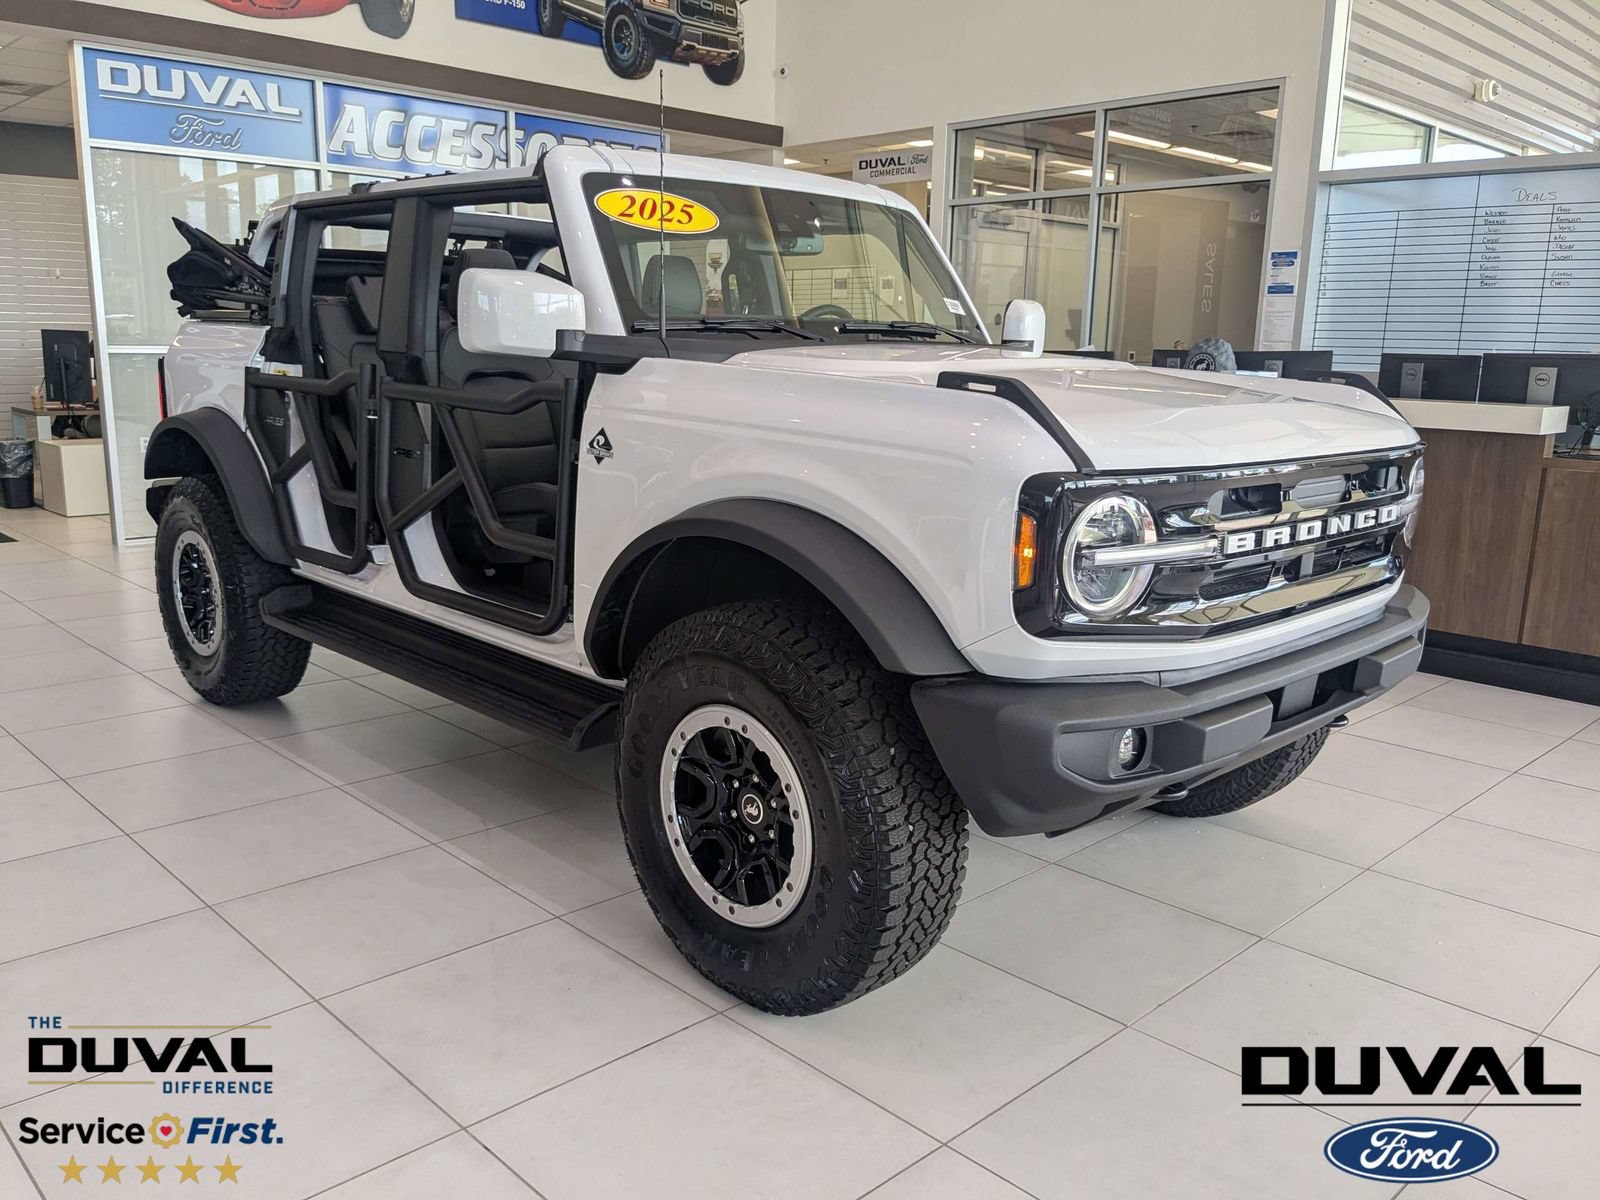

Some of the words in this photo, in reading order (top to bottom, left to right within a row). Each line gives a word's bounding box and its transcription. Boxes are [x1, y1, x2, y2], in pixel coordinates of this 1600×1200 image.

[96, 58, 301, 116] DUVAL
[169, 114, 243, 150] Ford
[327, 104, 657, 169] ACCESSO
[859, 156, 905, 170] DUVAL
[870, 166, 916, 178] COMMERCIAL
[617, 195, 694, 225] 2025
[1512, 187, 1557, 202] DEALS
[1224, 505, 1398, 554] BRONCO
